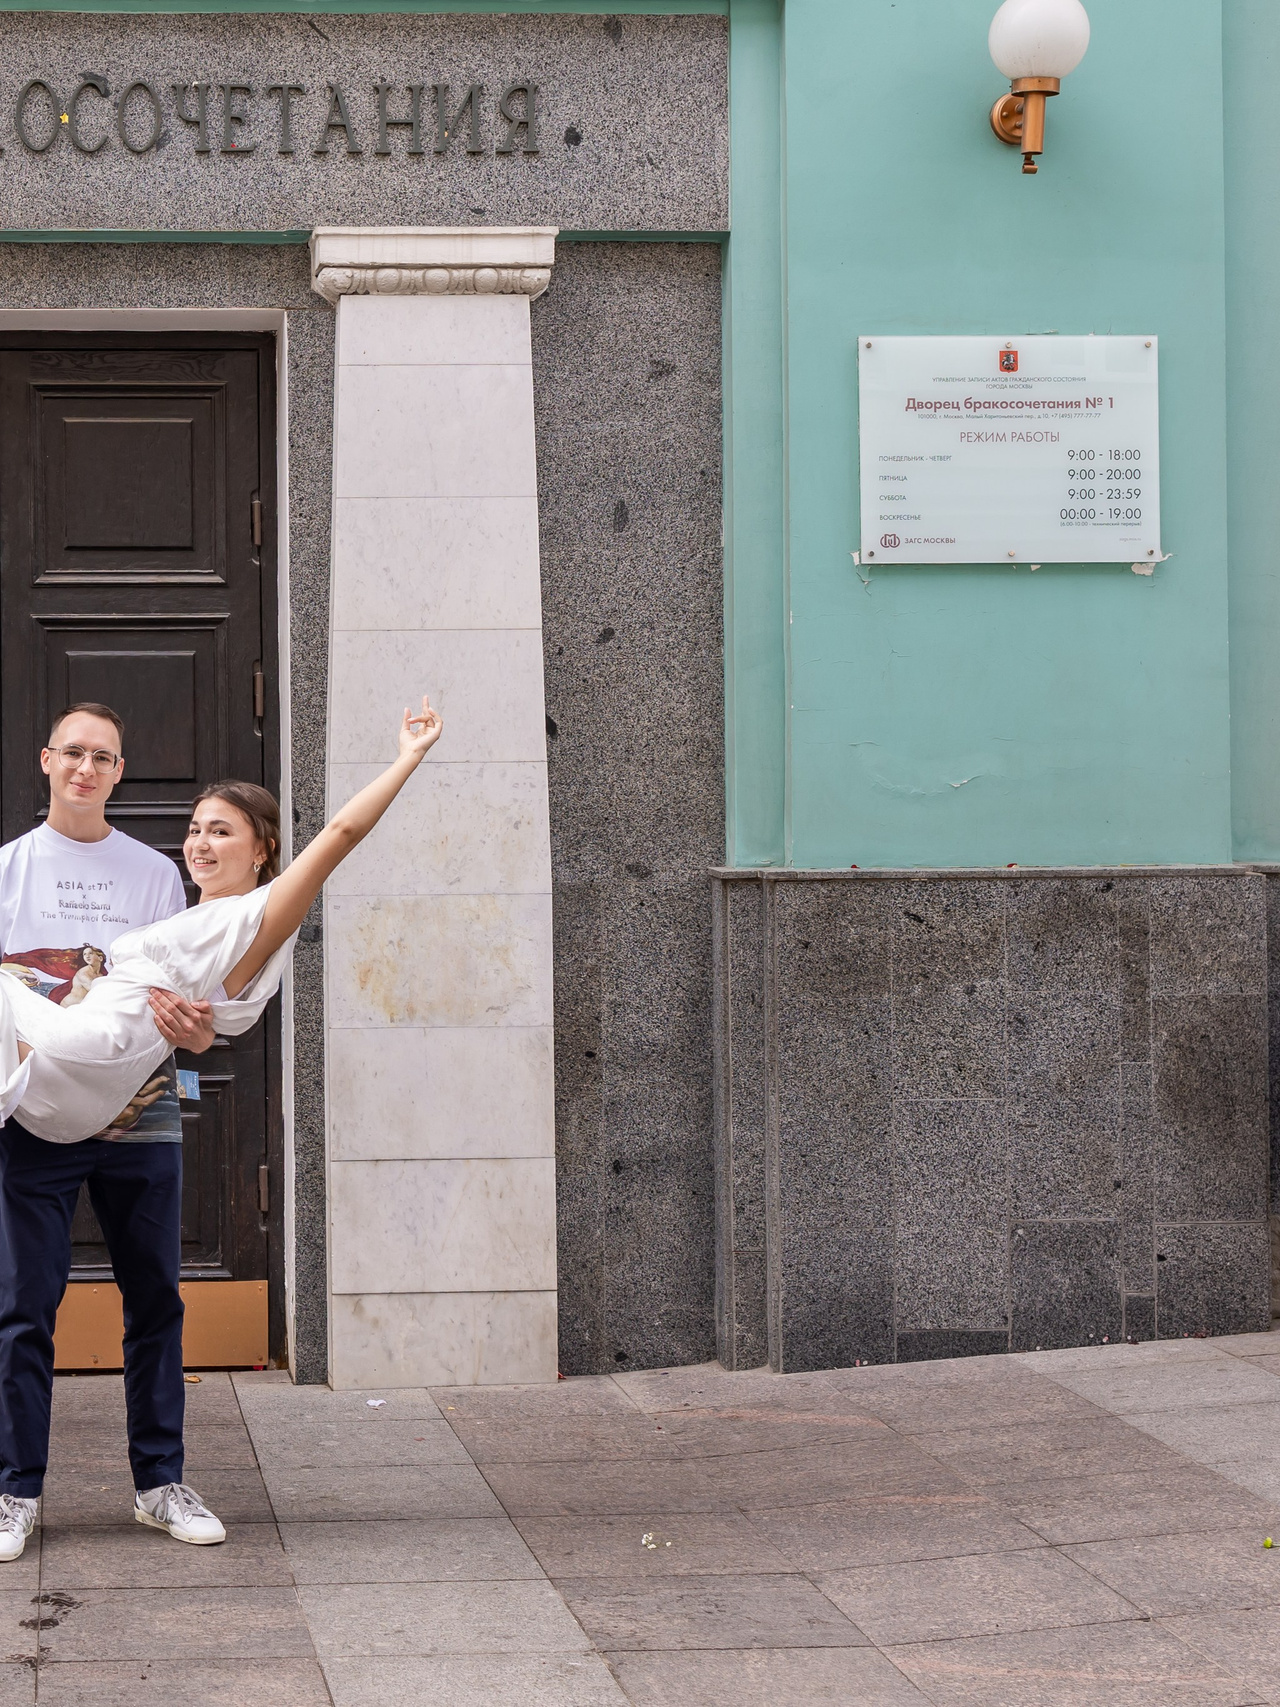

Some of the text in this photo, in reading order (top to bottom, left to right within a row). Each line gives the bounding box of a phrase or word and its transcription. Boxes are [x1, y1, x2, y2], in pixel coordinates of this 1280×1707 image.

[905, 396, 1114, 412] Дворец бракосочетания № 1
[960, 432, 1060, 442] РЕЖИМ РАБОТЫ
[1068, 450, 1095, 460] 9:00
[1108, 450, 1141, 460] 18:00
[1068, 469, 1096, 480] 9:00
[1106, 468, 1142, 480] 20:00
[1068, 488, 1096, 500] 9:00
[1106, 488, 1142, 500] 23:59
[1060, 508, 1096, 520] 00:00
[1108, 508, 1142, 520] 19:00
[56, 880, 84, 890] ASIA
[40, 911, 56, 919] The
